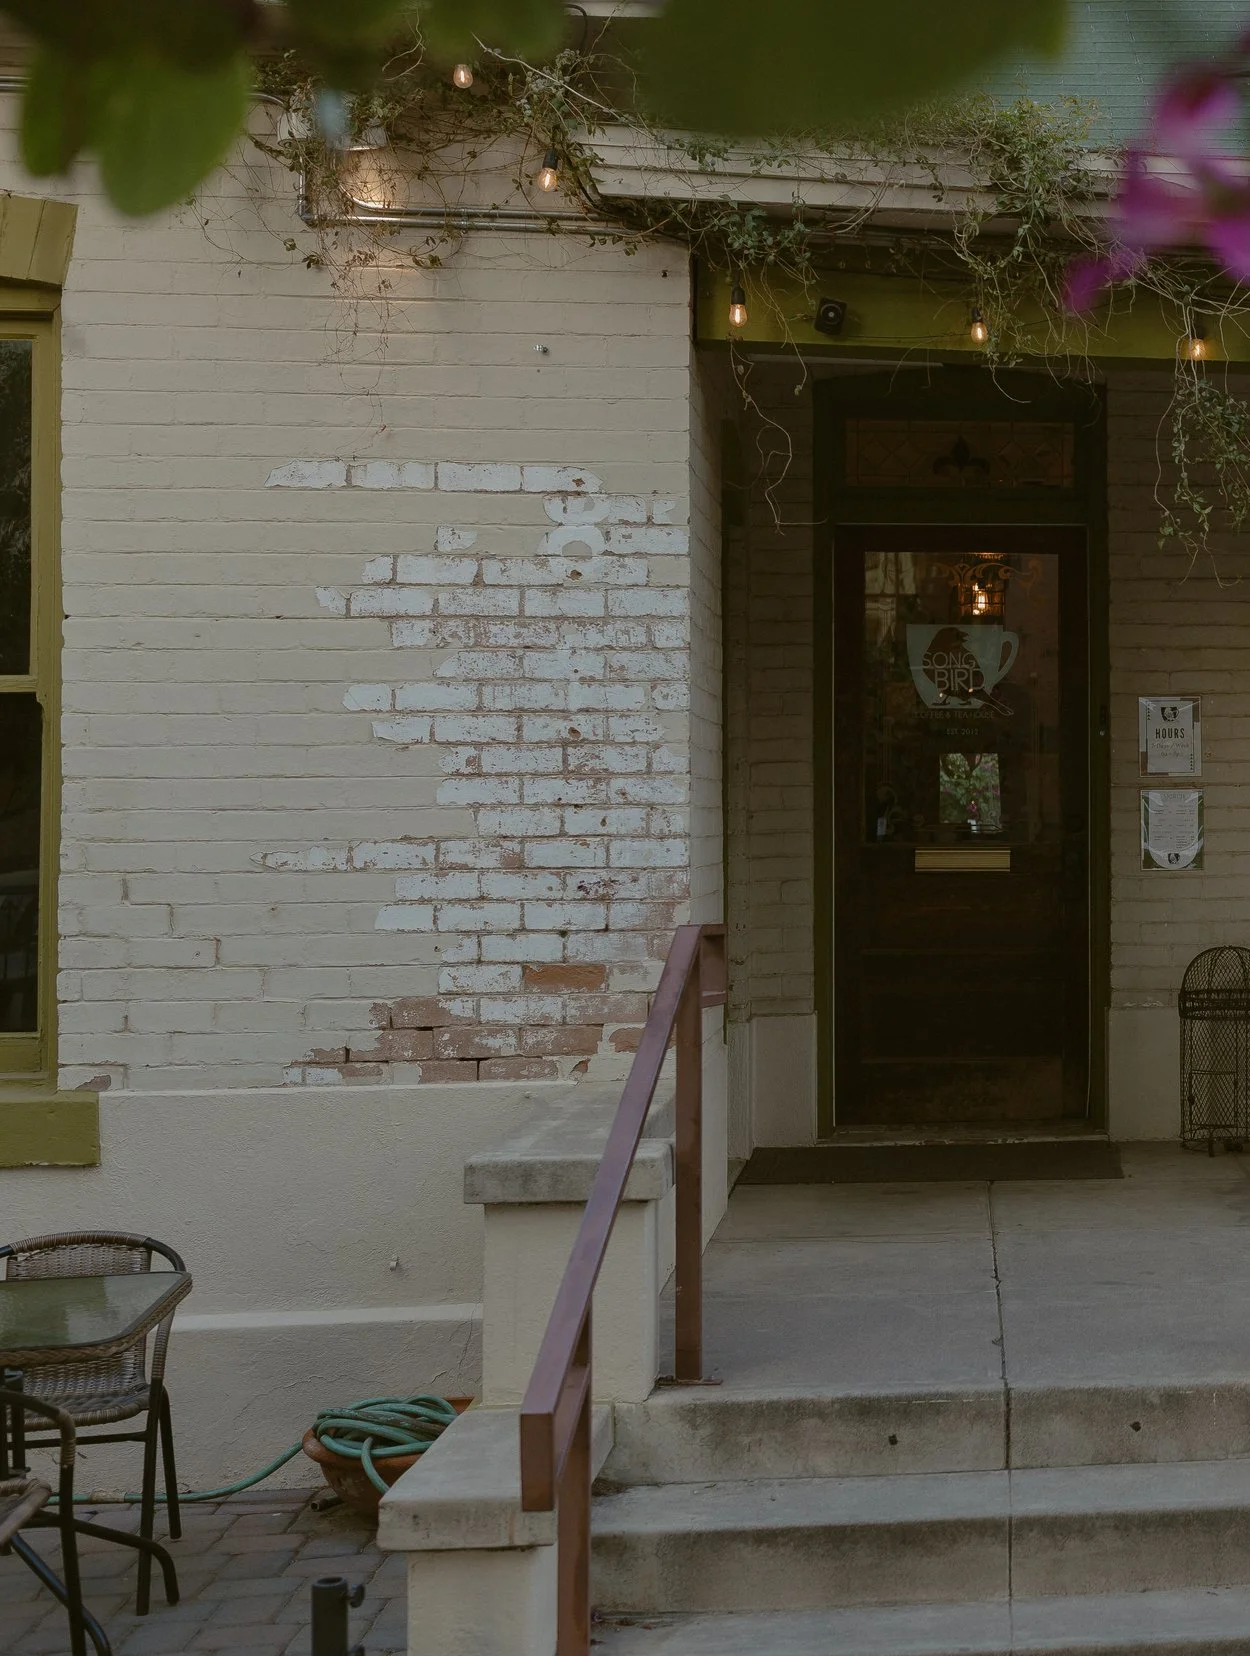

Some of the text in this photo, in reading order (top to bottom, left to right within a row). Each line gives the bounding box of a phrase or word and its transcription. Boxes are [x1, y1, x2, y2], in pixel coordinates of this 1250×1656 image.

[922, 651, 976, 669] SONG
[935, 668, 985, 691] BIRD
[1155, 727, 1185, 739] HOURS
